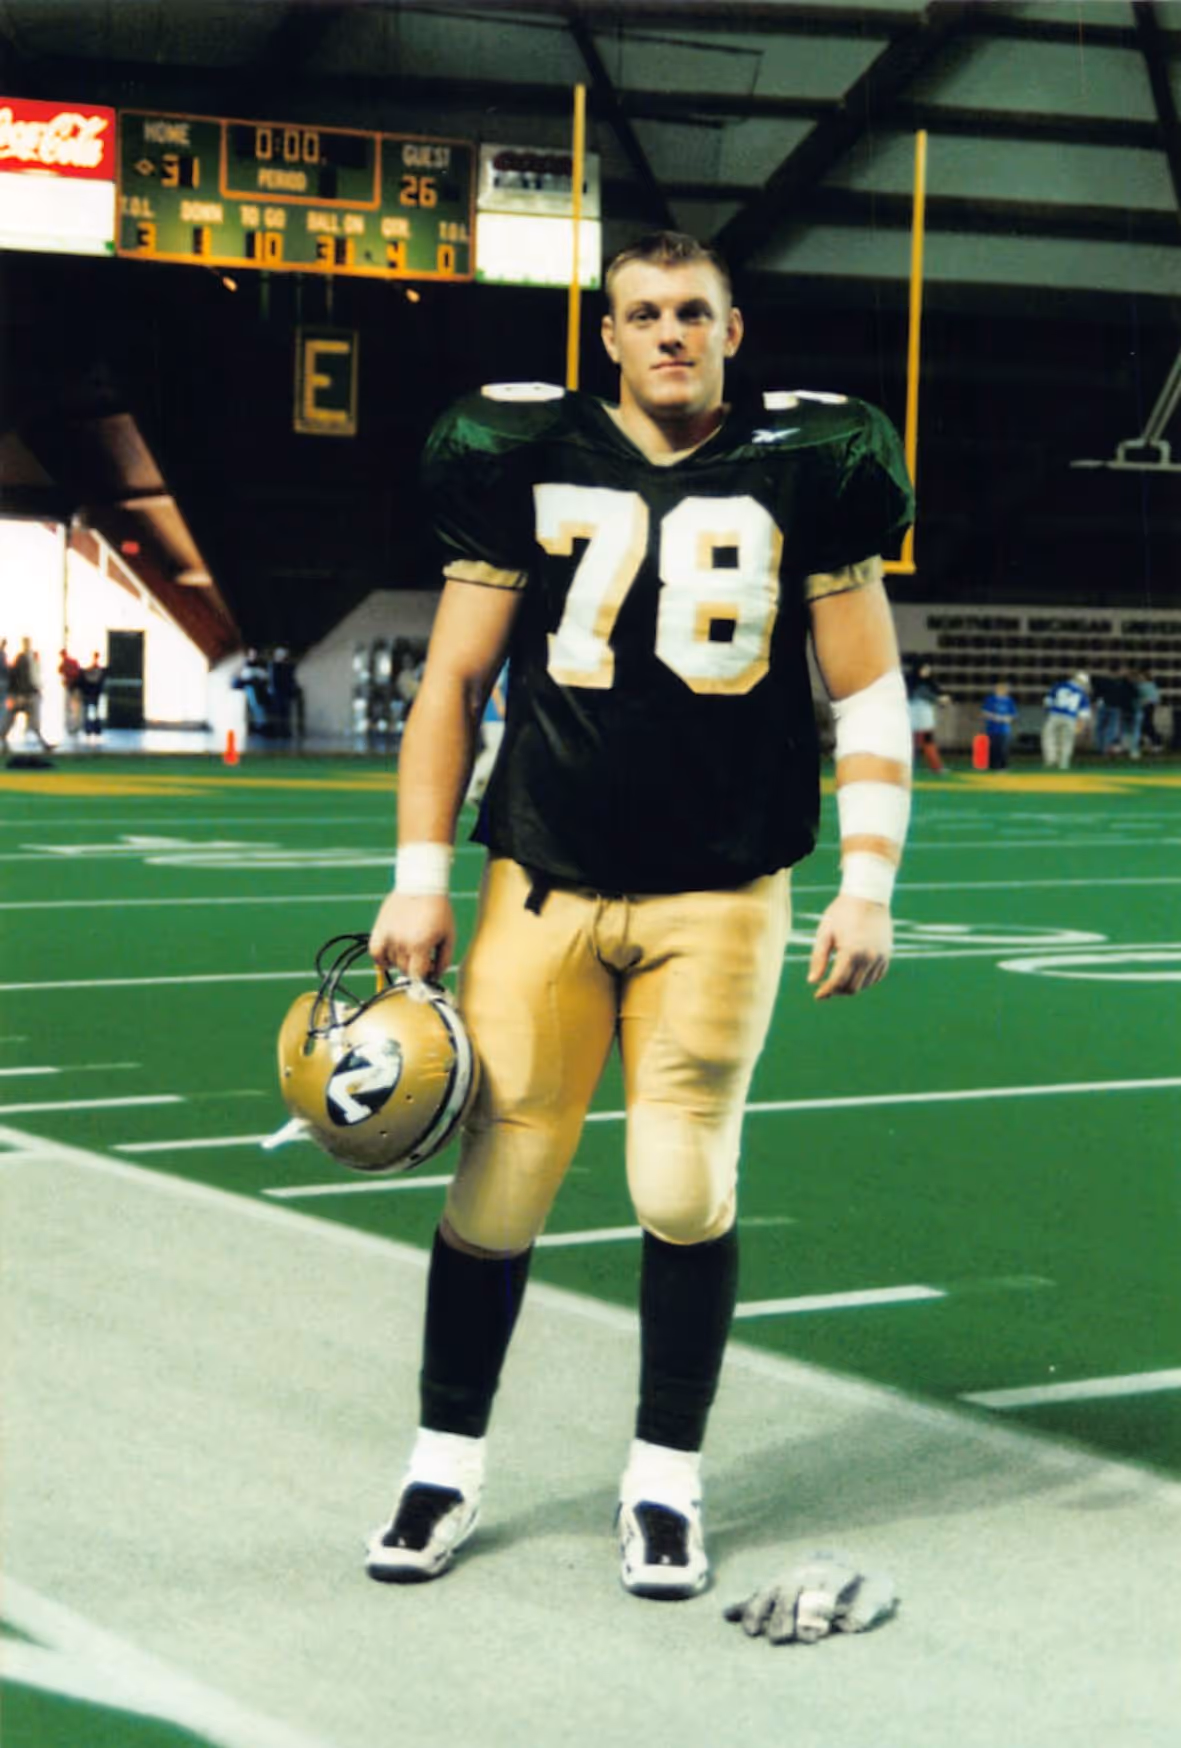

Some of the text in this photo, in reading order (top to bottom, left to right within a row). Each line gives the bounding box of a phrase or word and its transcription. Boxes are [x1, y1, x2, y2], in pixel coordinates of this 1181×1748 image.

[143, 120, 190, 146] HOME
[402, 144, 450, 168] GUEST
[160, 153, 200, 190] 31
[258, 168, 307, 192] PERIOD
[400, 175, 437, 208] 26
[180, 200, 223, 224] DOWN
[239, 204, 286, 230] TO GO
[306, 210, 365, 236] BALL ON
[137, 222, 157, 252] 3
[254, 231, 284, 263] 10
[437, 243, 456, 275] 0
[304, 339, 350, 423] E
[532, 482, 785, 695] 78
